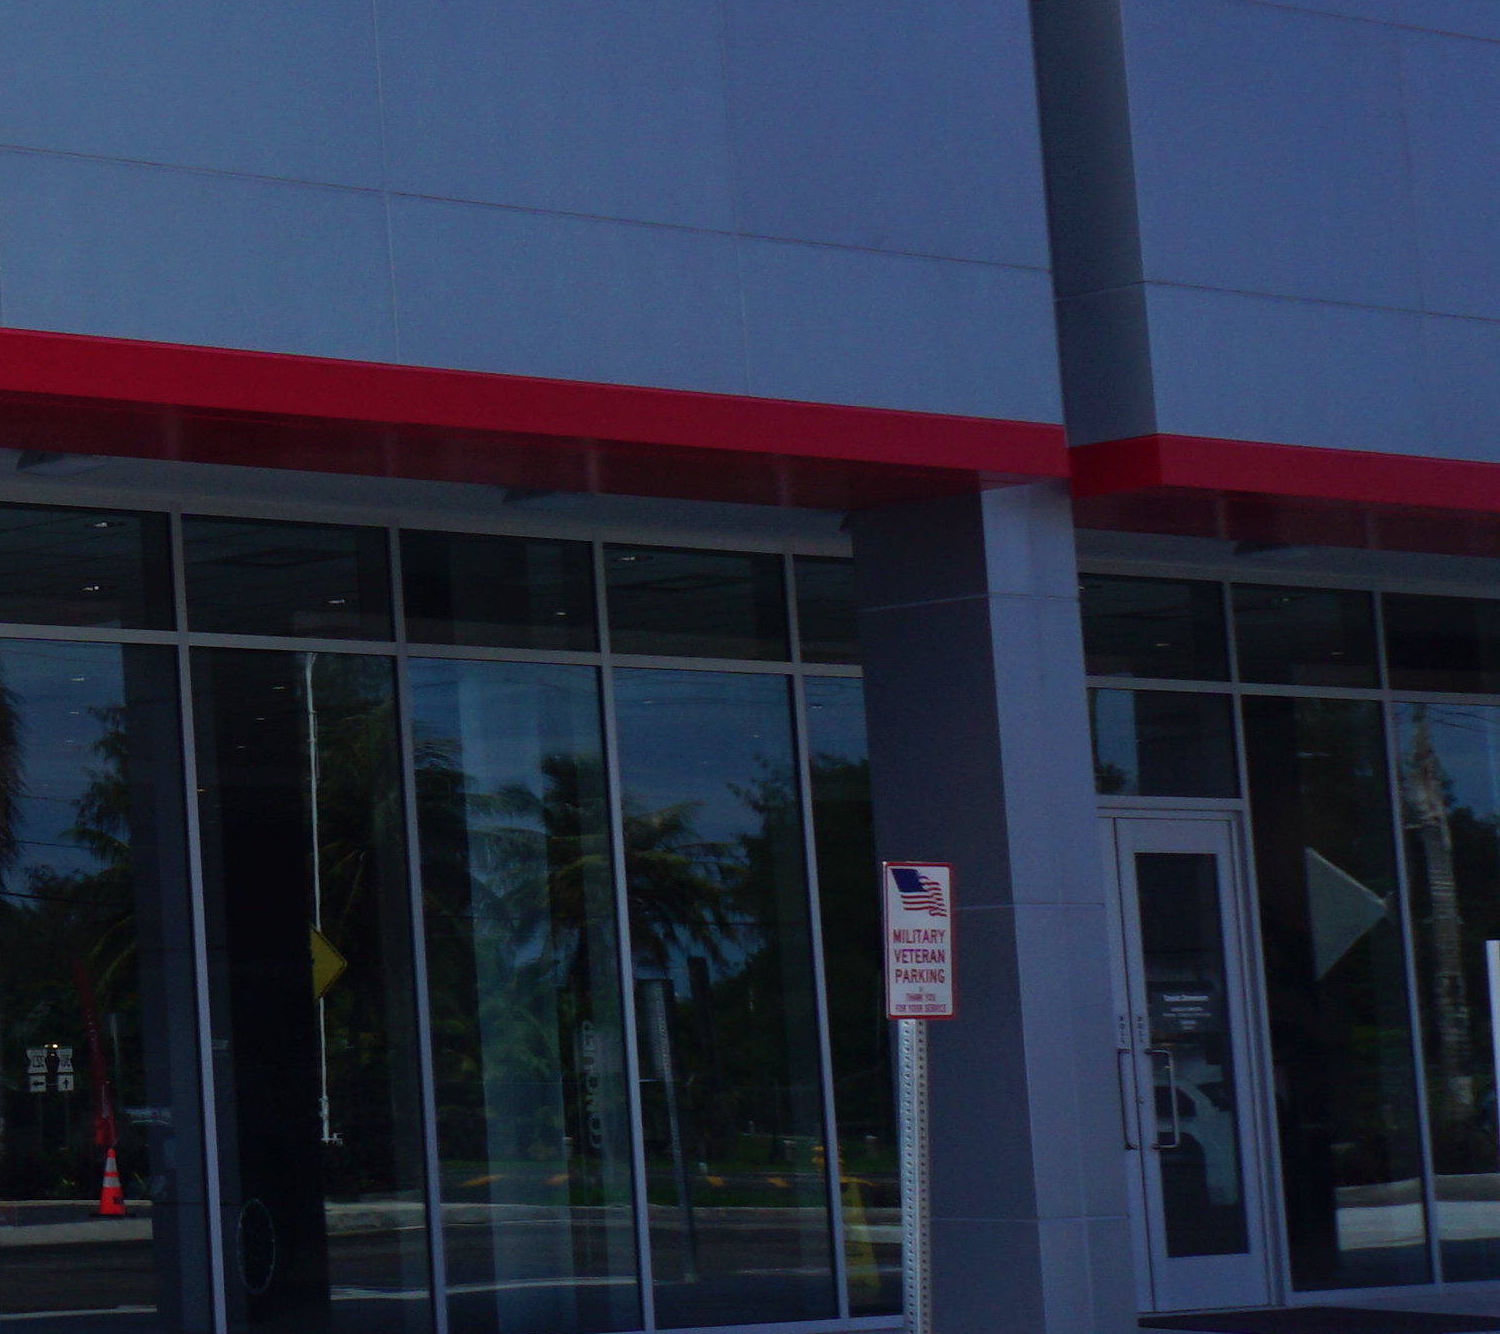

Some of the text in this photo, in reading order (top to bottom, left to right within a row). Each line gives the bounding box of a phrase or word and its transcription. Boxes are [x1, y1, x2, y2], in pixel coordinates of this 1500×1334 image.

[893, 929, 946, 944] MILITARY
[894, 949, 946, 964] VETERAN
[895, 969, 946, 984] PARKING
